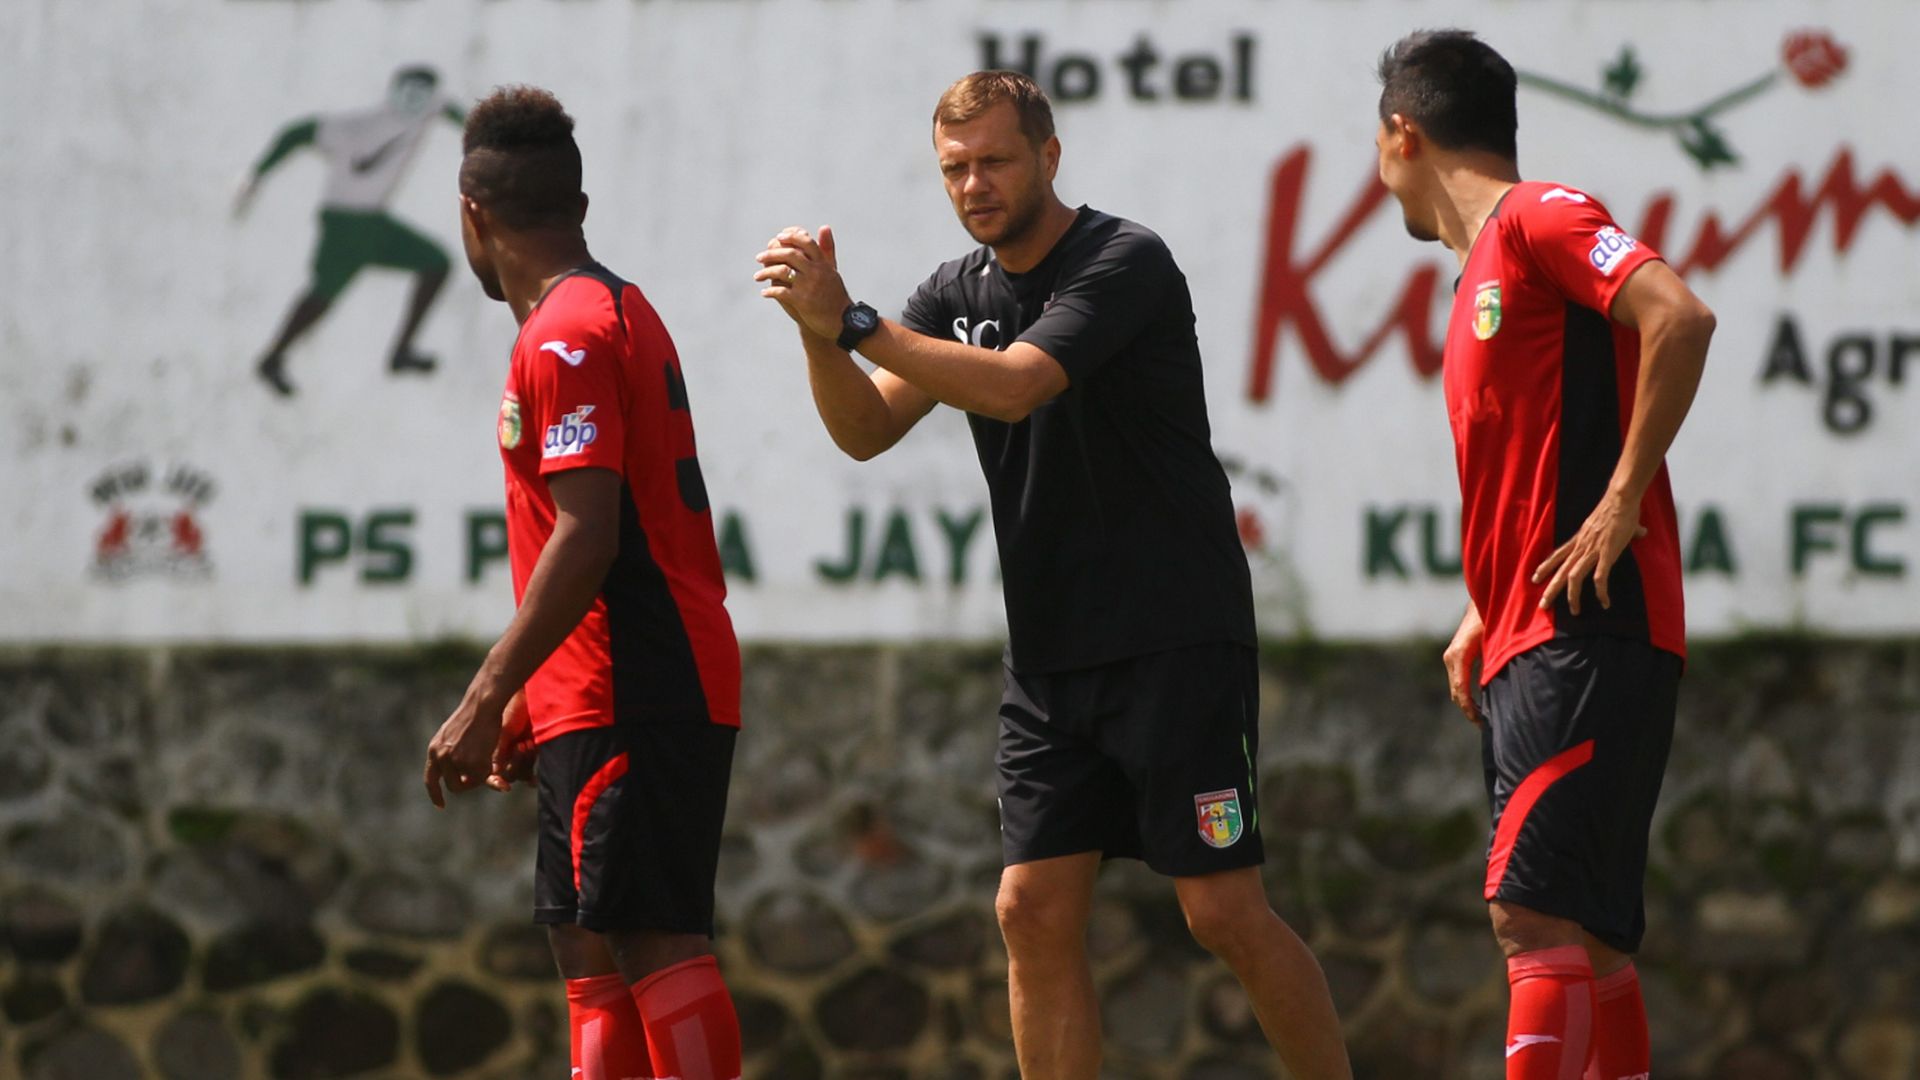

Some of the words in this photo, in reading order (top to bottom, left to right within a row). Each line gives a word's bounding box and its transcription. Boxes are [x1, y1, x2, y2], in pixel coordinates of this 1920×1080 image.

[977, 32, 1257, 104] Hotel
[1591, 231, 1635, 268] abp
[544, 415, 597, 452] abp
[300, 511, 414, 584] PS
[815, 507, 1003, 584] JAY
[1792, 508, 1906, 575] FC
